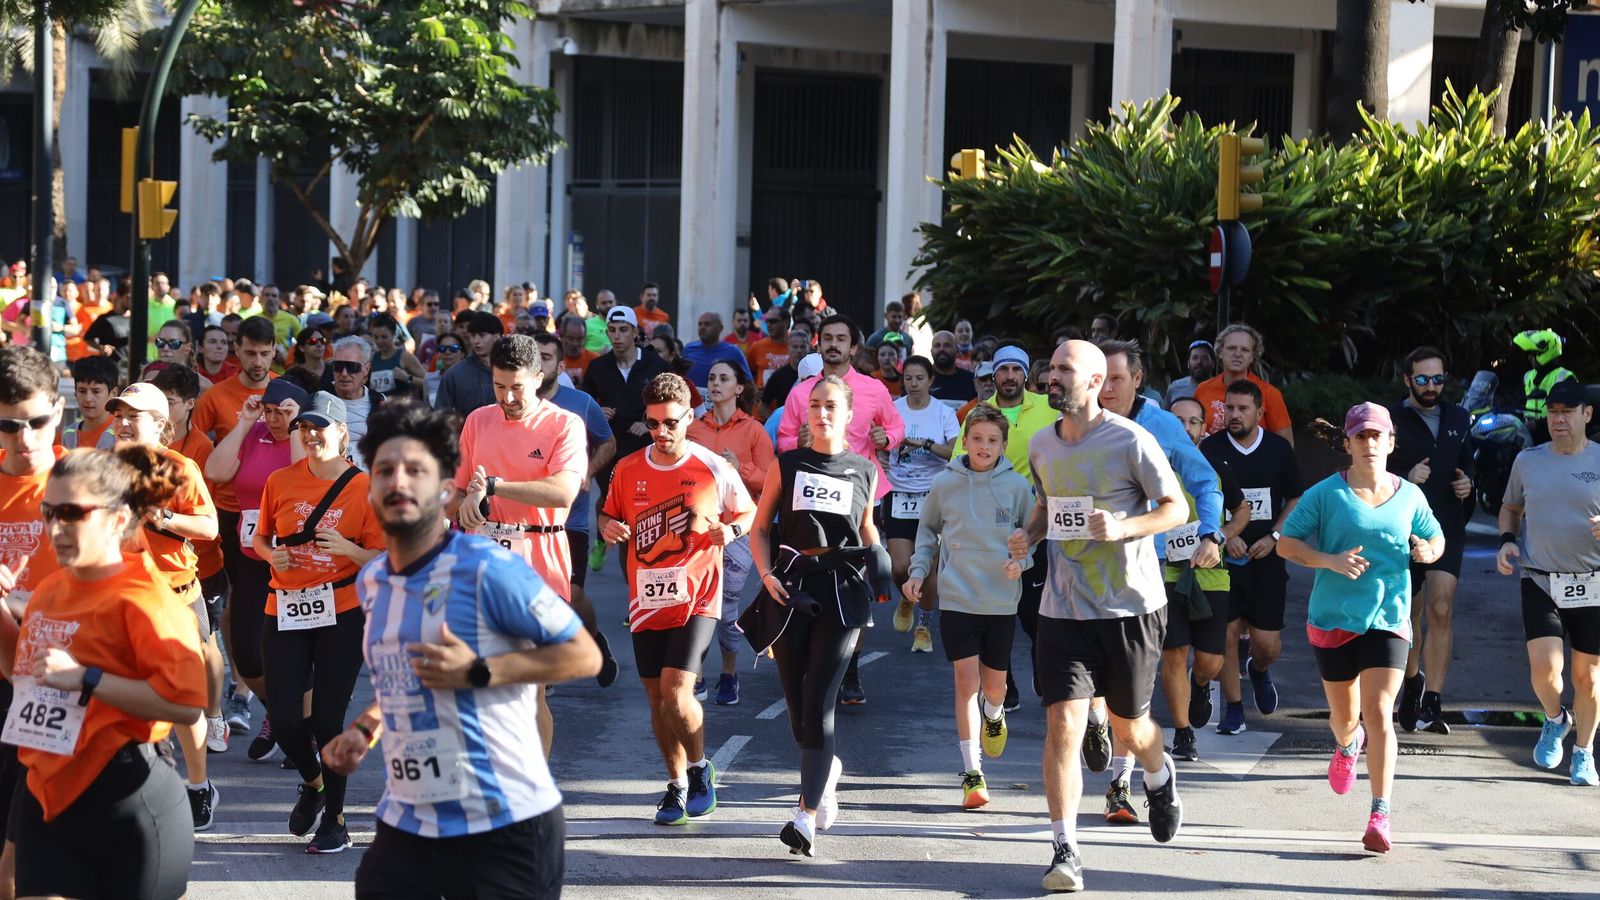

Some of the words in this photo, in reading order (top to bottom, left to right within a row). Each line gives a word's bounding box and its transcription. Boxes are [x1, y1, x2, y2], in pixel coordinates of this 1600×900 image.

[802, 485, 841, 502] 624
[901, 501, 918, 511] 17
[636, 512, 662, 535] FLYING
[1054, 512, 1085, 527] 465
[636, 524, 662, 551] FEET
[644, 581, 679, 598] 374
[1564, 584, 1586, 598] 29
[286, 599, 325, 618] 309
[19, 701, 67, 731] 482
[391, 755, 441, 781] 961
